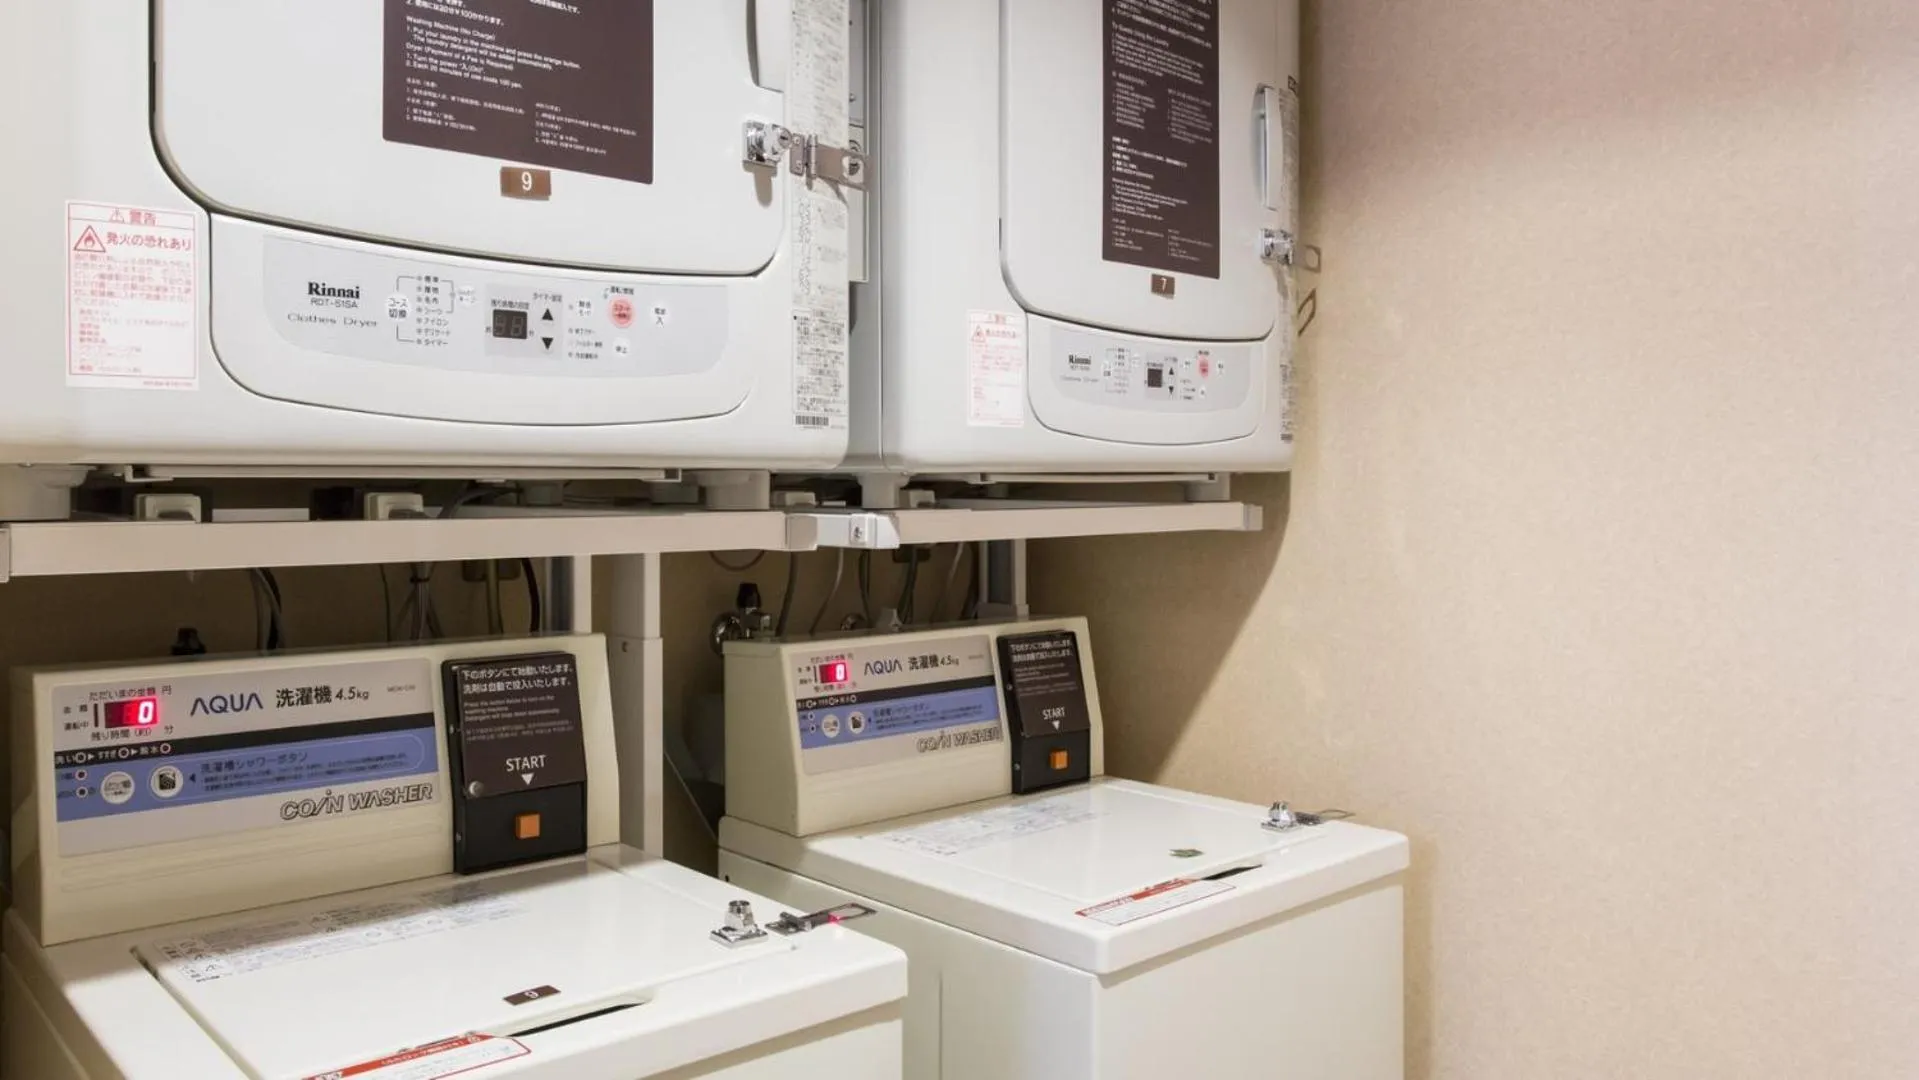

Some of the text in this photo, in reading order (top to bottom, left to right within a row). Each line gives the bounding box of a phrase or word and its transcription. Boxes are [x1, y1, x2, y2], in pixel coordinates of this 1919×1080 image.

[522, 171, 532, 191] 9
[106, 231, 192, 251] 発火の恐れあり
[307, 281, 360, 299] Rinnai
[1160, 277, 1168, 293] 7
[287, 313, 378, 327] Clothes Dryer
[836, 663, 845, 681] 0
[864, 660, 903, 676] AQUA
[908, 655, 939, 671] 洗濯機
[162, 685, 172, 696] 円
[189, 685, 369, 716] AQUA 洗濯機 4.5kg
[138, 701, 154, 725] 0
[1042, 706, 1066, 720] START
[164, 725, 174, 735] 分
[505, 754, 546, 772] START
[280, 783, 433, 820] COIN WASHER
